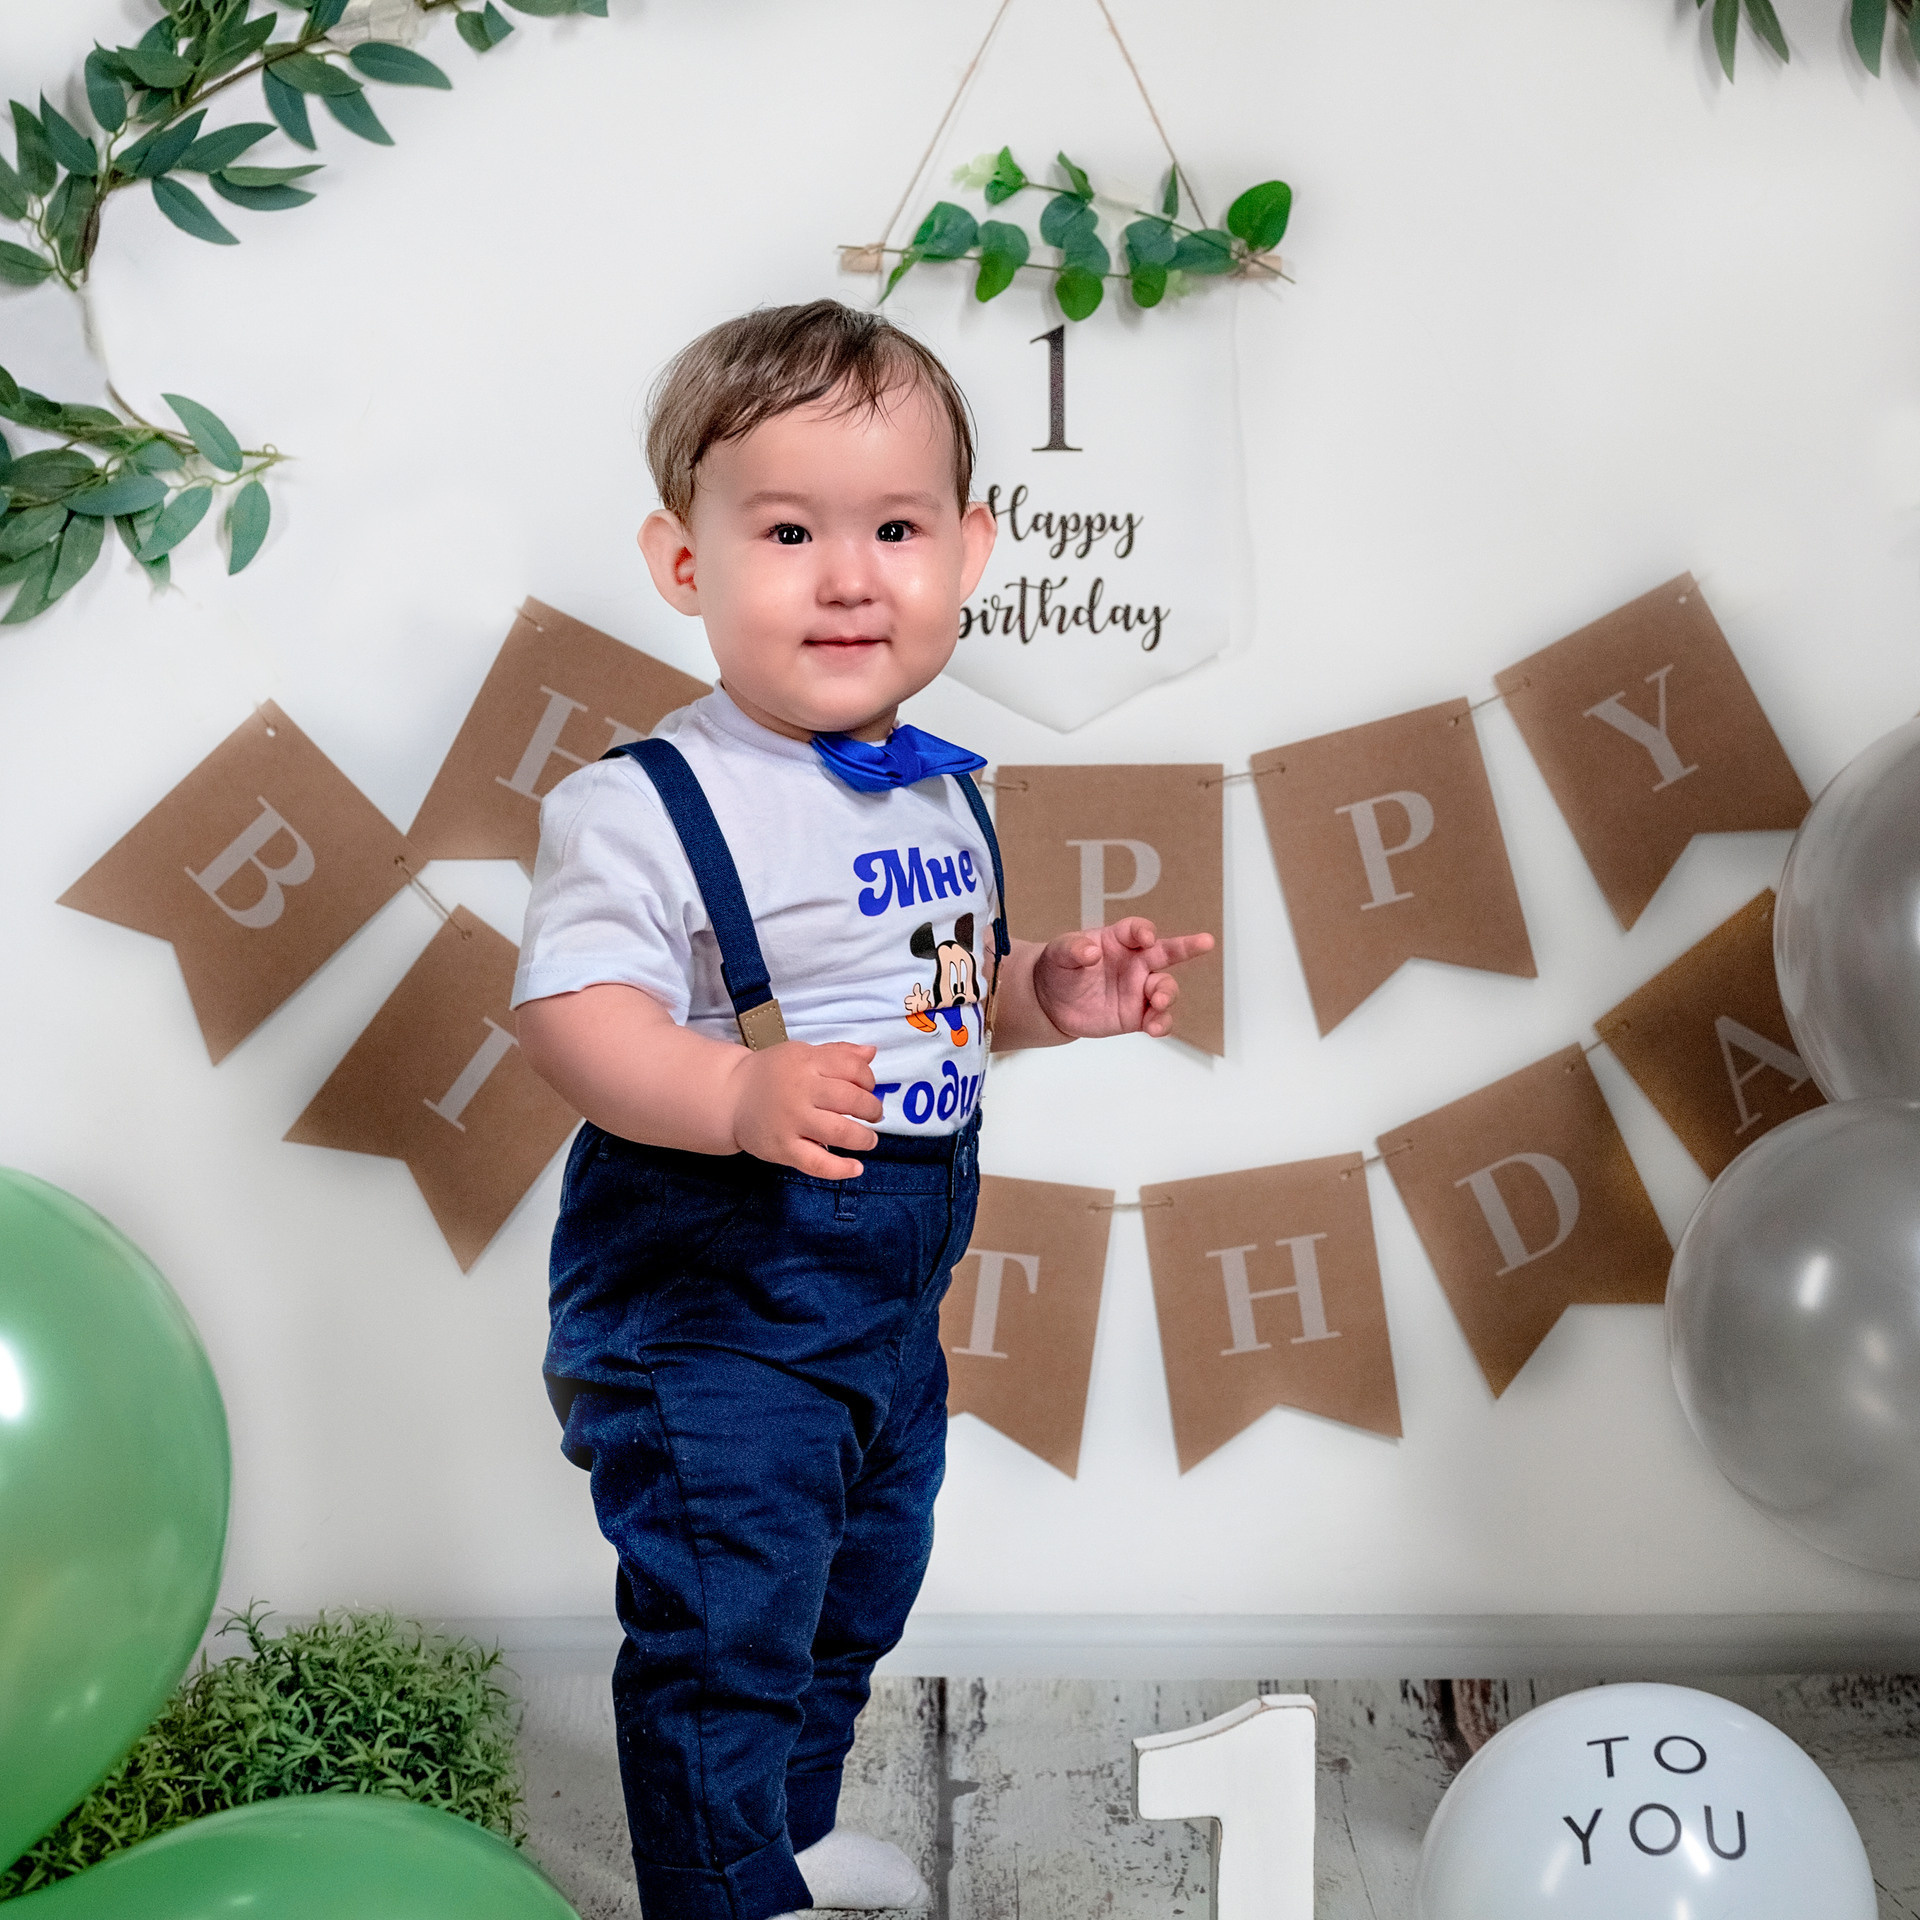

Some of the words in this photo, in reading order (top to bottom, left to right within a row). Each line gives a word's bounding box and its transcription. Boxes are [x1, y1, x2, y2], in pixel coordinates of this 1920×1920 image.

[1030, 324, 1084, 453] 1
[853, 846, 977, 917] Мне
[1586, 1735, 1708, 1778] TO
[1562, 1803, 1747, 1866] YOU
